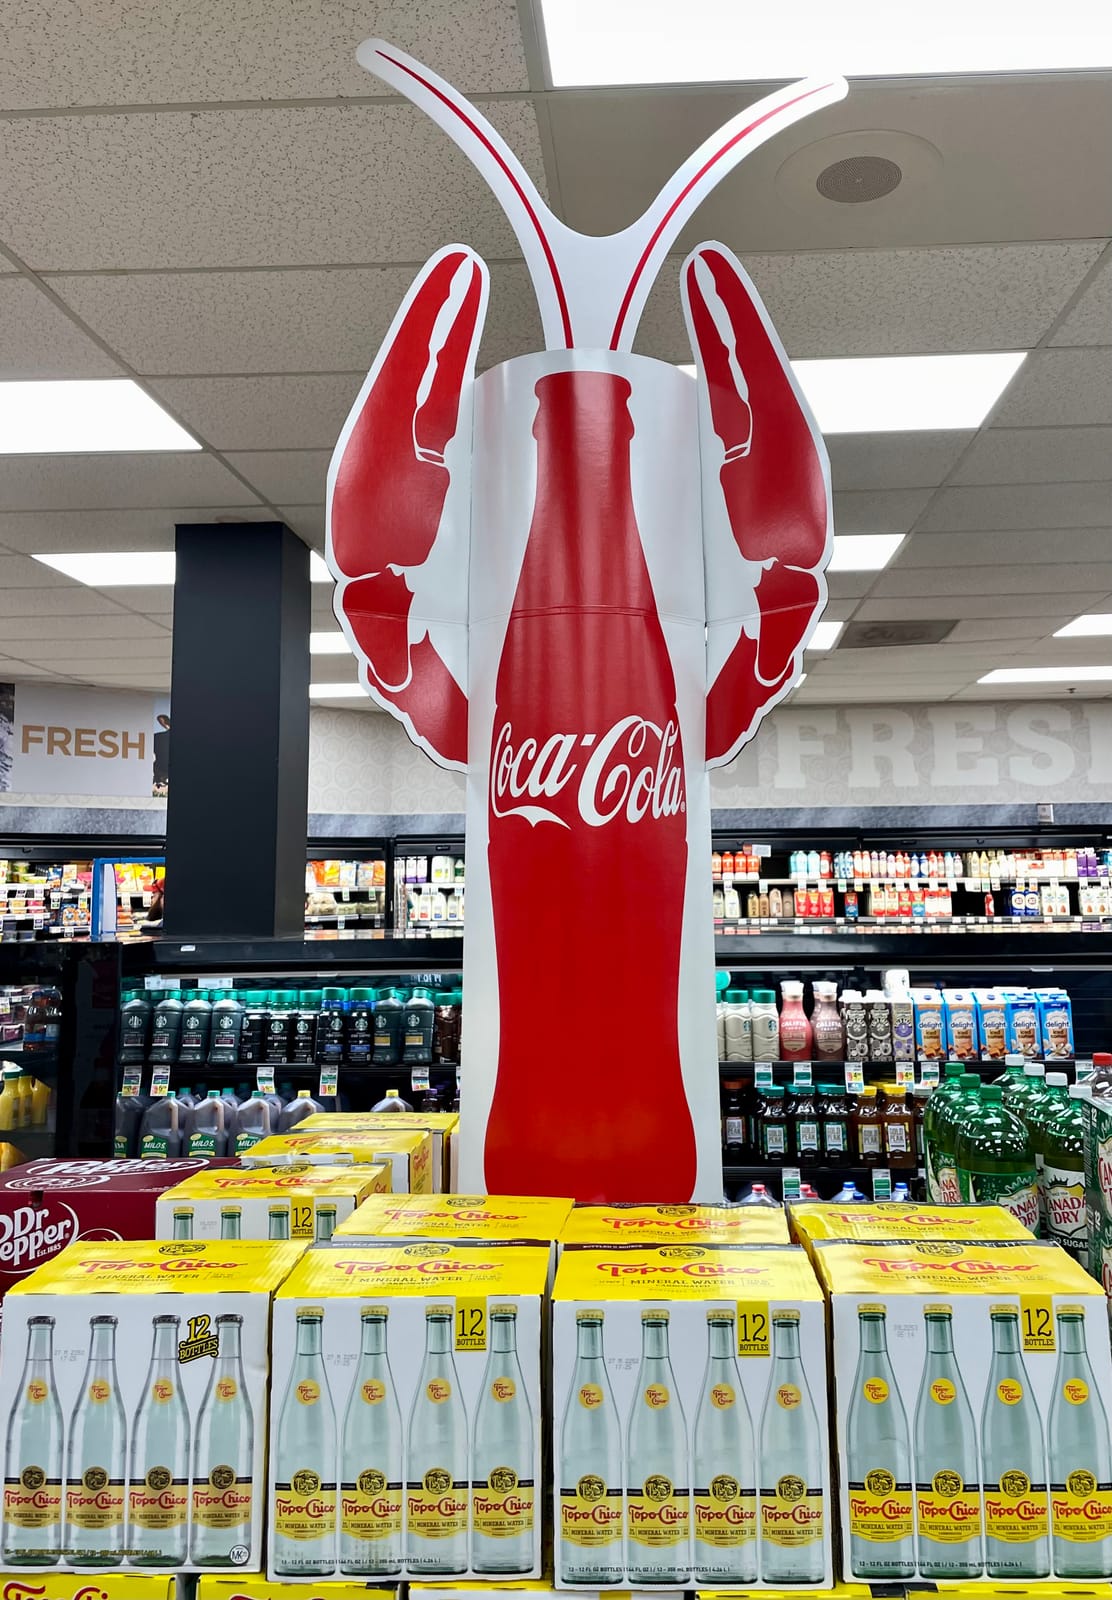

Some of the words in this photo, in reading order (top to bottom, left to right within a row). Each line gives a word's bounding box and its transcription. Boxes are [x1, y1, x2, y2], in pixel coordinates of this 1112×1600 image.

[21, 724, 146, 760] FRESH
[487, 714, 683, 830] Coca-Cola
[919, 1020, 943, 1030] delight
[950, 1020, 974, 1030] delight
[982, 1020, 1006, 1030] delight
[1013, 1020, 1037, 1029] delight
[1045, 1020, 1070, 1029] delight
[214, 1177, 272, 1188] Topo
[274, 1176, 341, 1187] Chico
[14, 1207, 49, 1239] Dr
[292, 1207, 313, 1228] 12
[384, 1208, 448, 1220] Topo
[452, 1210, 527, 1221] Chico
[602, 1217, 673, 1229] Topo
[674, 1217, 748, 1230] Chico
[827, 1212, 900, 1225] Topo
[902, 1213, 980, 1225] Chico
[1053, 1210, 1079, 1225] DRY
[79, 1259, 157, 1273] Topo
[158, 1258, 247, 1272] Chico
[334, 1260, 417, 1275] Topo
[417, 1259, 503, 1274] Chico
[597, 1262, 680, 1277] Topo
[681, 1262, 768, 1277] Chico
[863, 1258, 947, 1273] Topo
[949, 1259, 1040, 1274] Chico
[187, 1314, 211, 1343] 12
[457, 1308, 484, 1337] 12
[740, 1313, 767, 1342] 12
[1023, 1308, 1052, 1337] 12
[178, 1338, 219, 1360] BOTTLES
[456, 1338, 486, 1346] BOTTLES
[739, 1343, 769, 1351] BOTTLES
[1024, 1338, 1055, 1346] BOTTLES
[4, 1490, 33, 1507] Topo
[32, 1491, 61, 1508] Chico
[66, 1492, 95, 1508] Topo
[95, 1492, 124, 1509] Chico
[129, 1491, 159, 1509] Topo
[159, 1491, 187, 1509] Chico
[193, 1491, 222, 1508] Topo
[222, 1490, 251, 1508] Chico
[276, 1498, 306, 1517] Topo
[306, 1498, 335, 1518] Chico
[342, 1498, 372, 1517] Topo
[371, 1498, 402, 1518] Chico
[408, 1497, 438, 1516] Topo
[438, 1497, 467, 1517] Chico
[474, 1496, 504, 1515] Topo
[503, 1495, 533, 1516] Chico
[562, 1504, 592, 1523] Topo
[592, 1504, 622, 1525] Chico
[629, 1504, 660, 1523] Topo
[659, 1504, 689, 1525] Chico
[695, 1504, 726, 1523] Topo
[725, 1504, 756, 1525] Chico
[761, 1504, 793, 1523] Topo
[792, 1504, 822, 1525] Chico
[851, 1498, 882, 1518] Topo
[881, 1499, 912, 1520] Chico
[918, 1499, 950, 1519] Topo
[949, 1500, 979, 1521] Chico
[986, 1500, 1017, 1519] Topo
[1016, 1500, 1047, 1520] Chico
[1053, 1500, 1084, 1519] Topo
[1083, 1499, 1112, 1520] Chico
